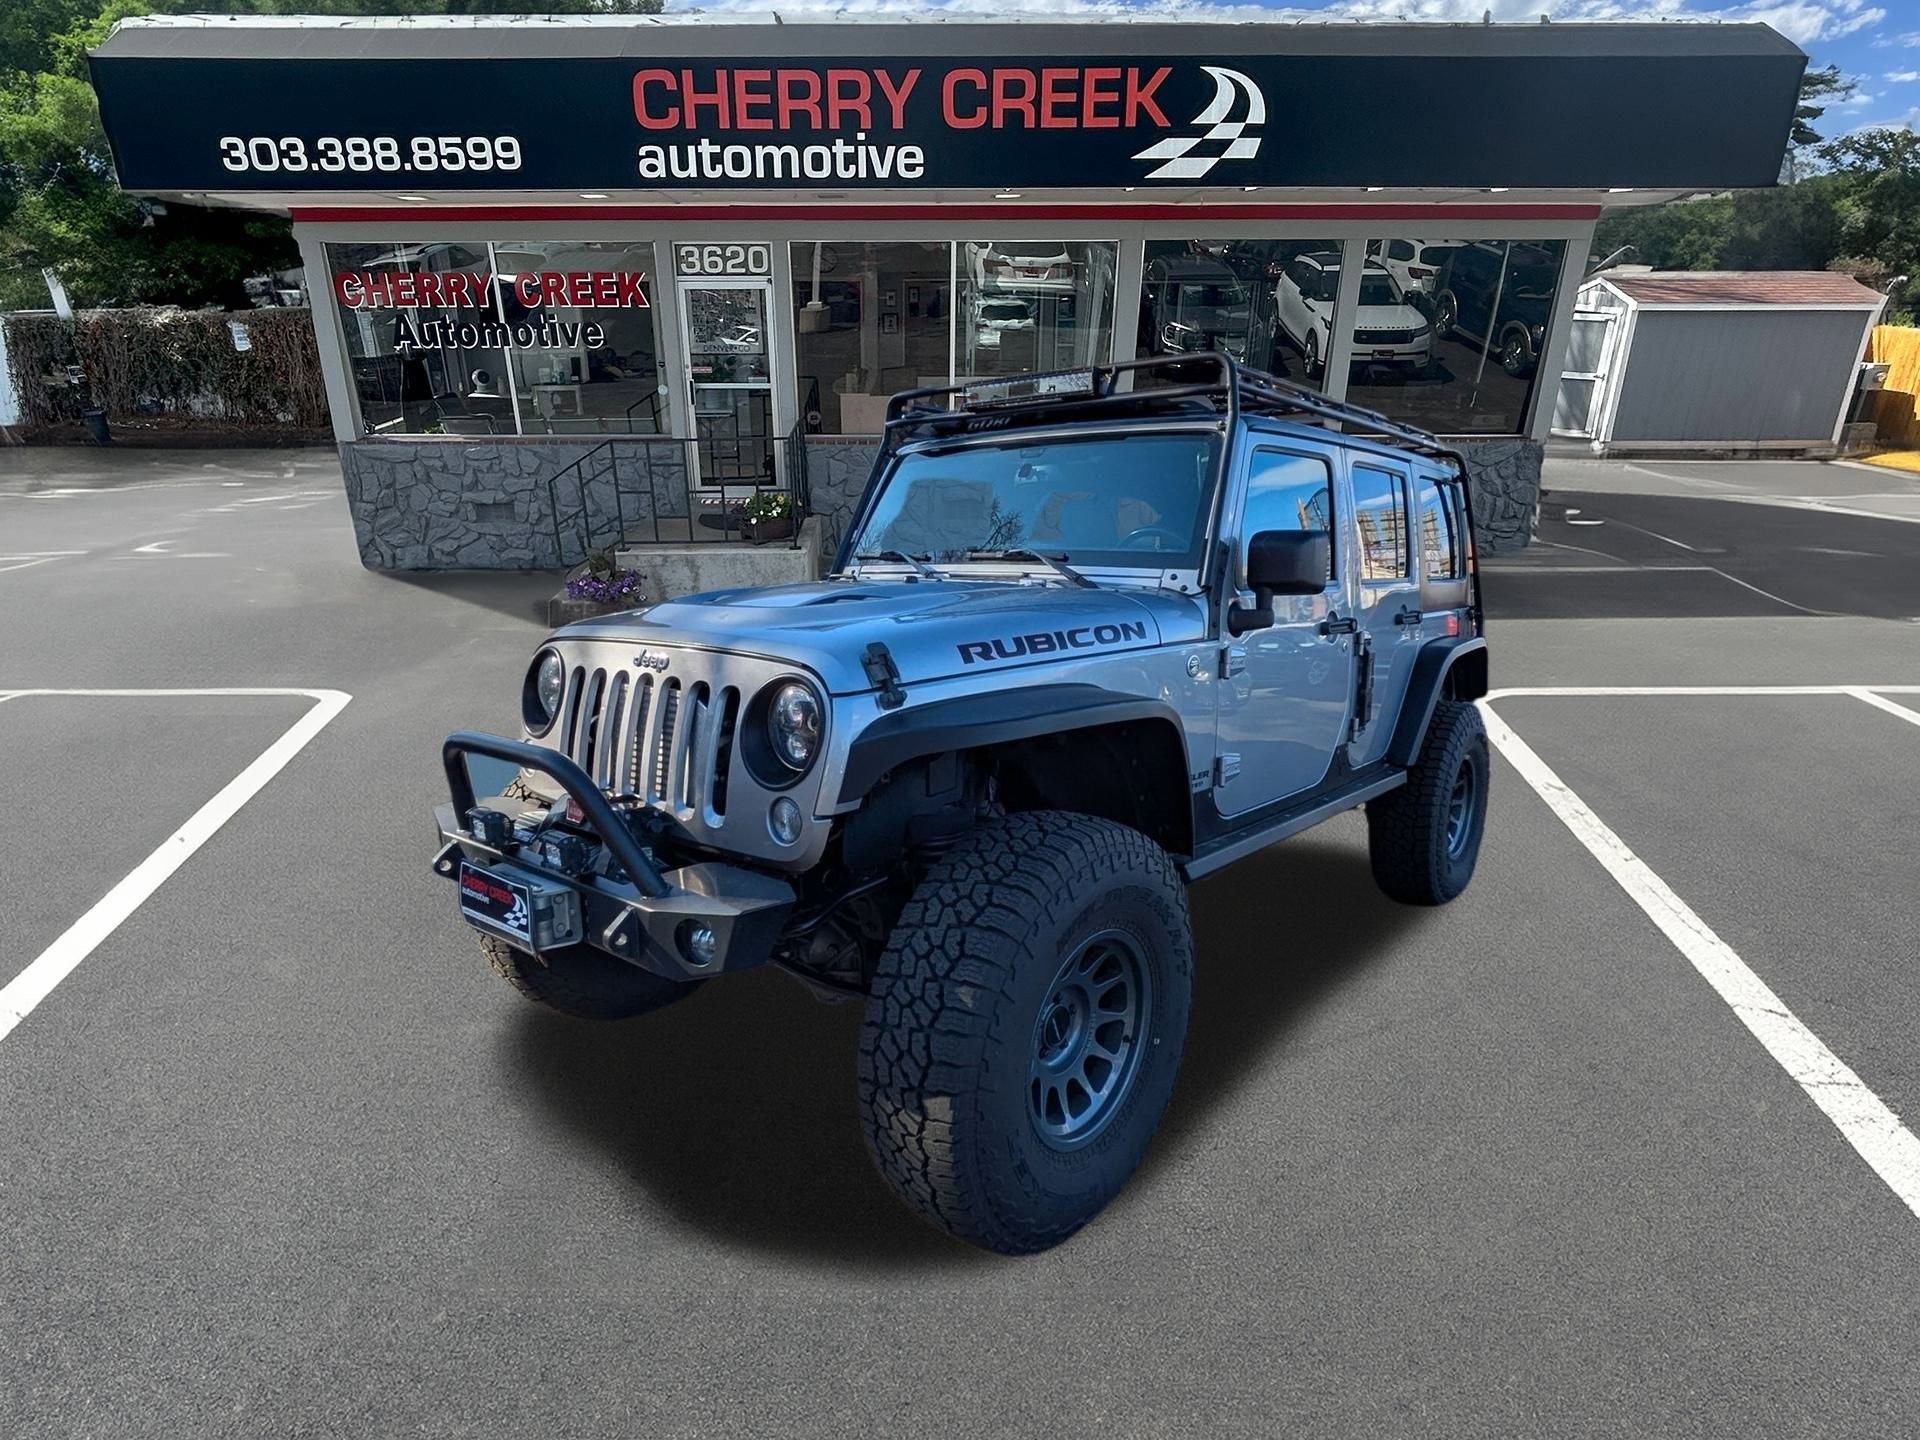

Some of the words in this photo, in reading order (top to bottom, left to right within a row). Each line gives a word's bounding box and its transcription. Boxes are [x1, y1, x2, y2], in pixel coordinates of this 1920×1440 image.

[632, 68, 922, 130] CHERRY
[942, 67, 1172, 129] CREEK
[220, 136, 522, 171] 303.388.8599
[638, 132, 925, 179] automotive
[680, 245, 769, 274] 3620
[335, 271, 494, 308] CHERRY
[514, 271, 650, 308] CREEK
[393, 312, 604, 350] Automotive
[633, 648, 670, 673] Jeep
[957, 621, 1147, 664] RUBICON
